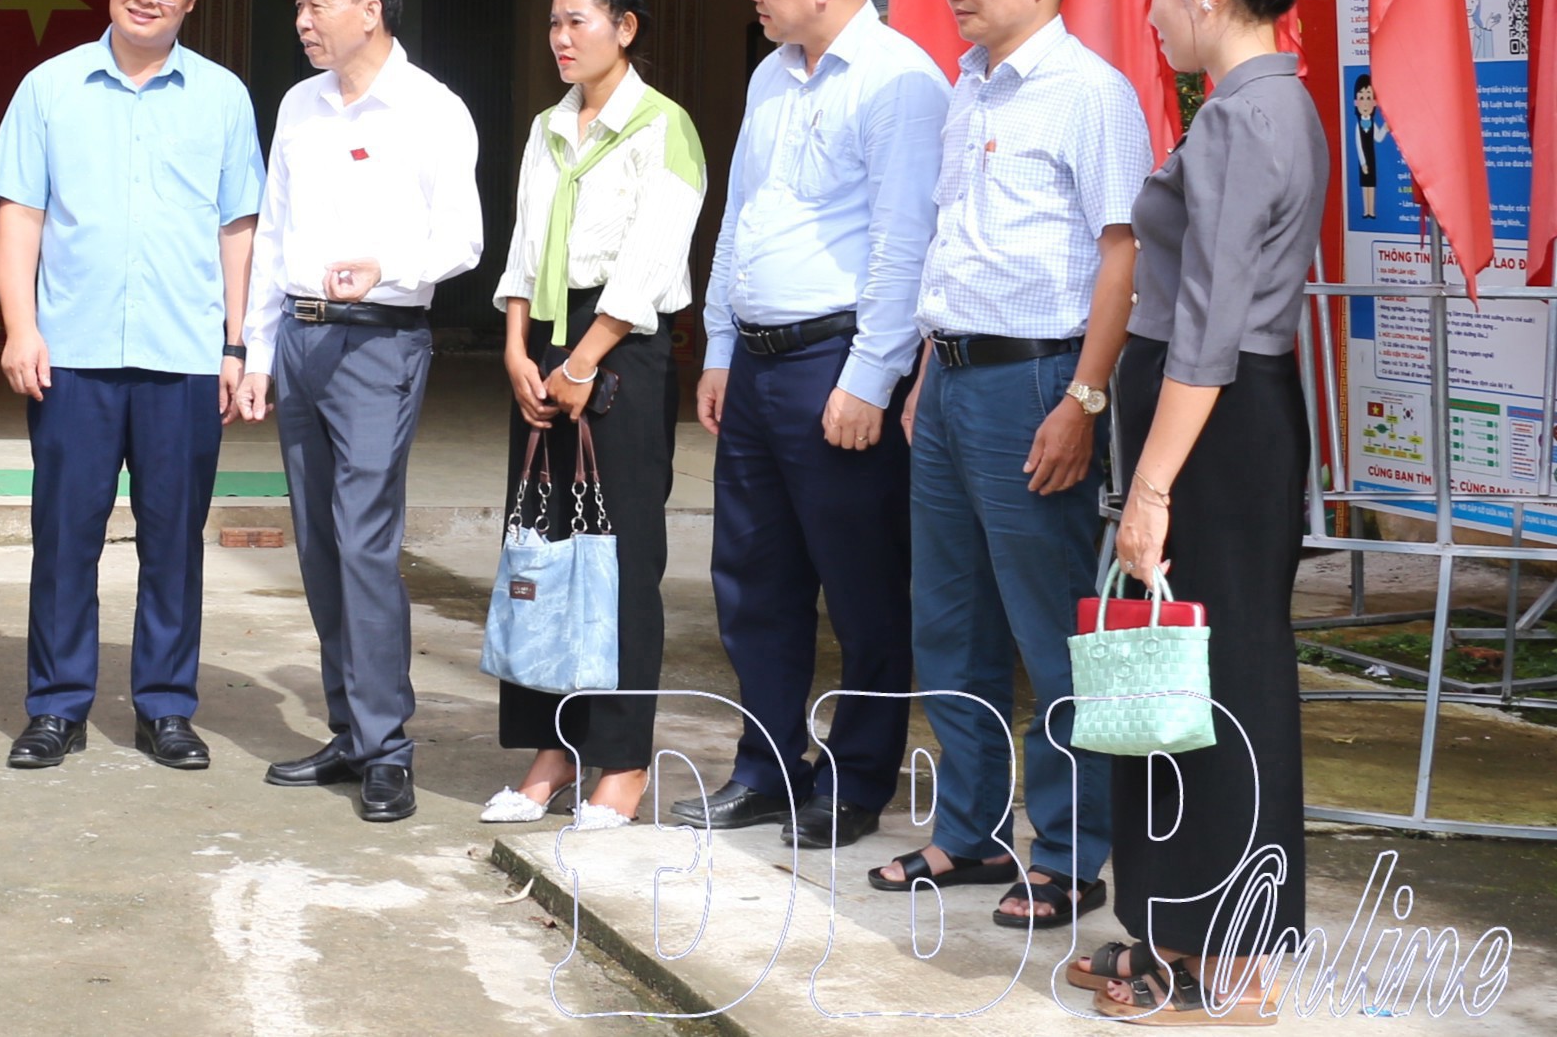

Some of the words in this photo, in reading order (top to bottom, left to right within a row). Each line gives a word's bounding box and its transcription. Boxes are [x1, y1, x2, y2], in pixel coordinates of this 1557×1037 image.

[1378, 248, 1412, 263] THÔNG
[1414, 252, 1431, 264] TIN
[1494, 258, 1516, 269] LAO
[1368, 464, 1393, 479] CÙNG
[1394, 470, 1414, 483] BẠN
[1416, 471, 1432, 485] TÌM
